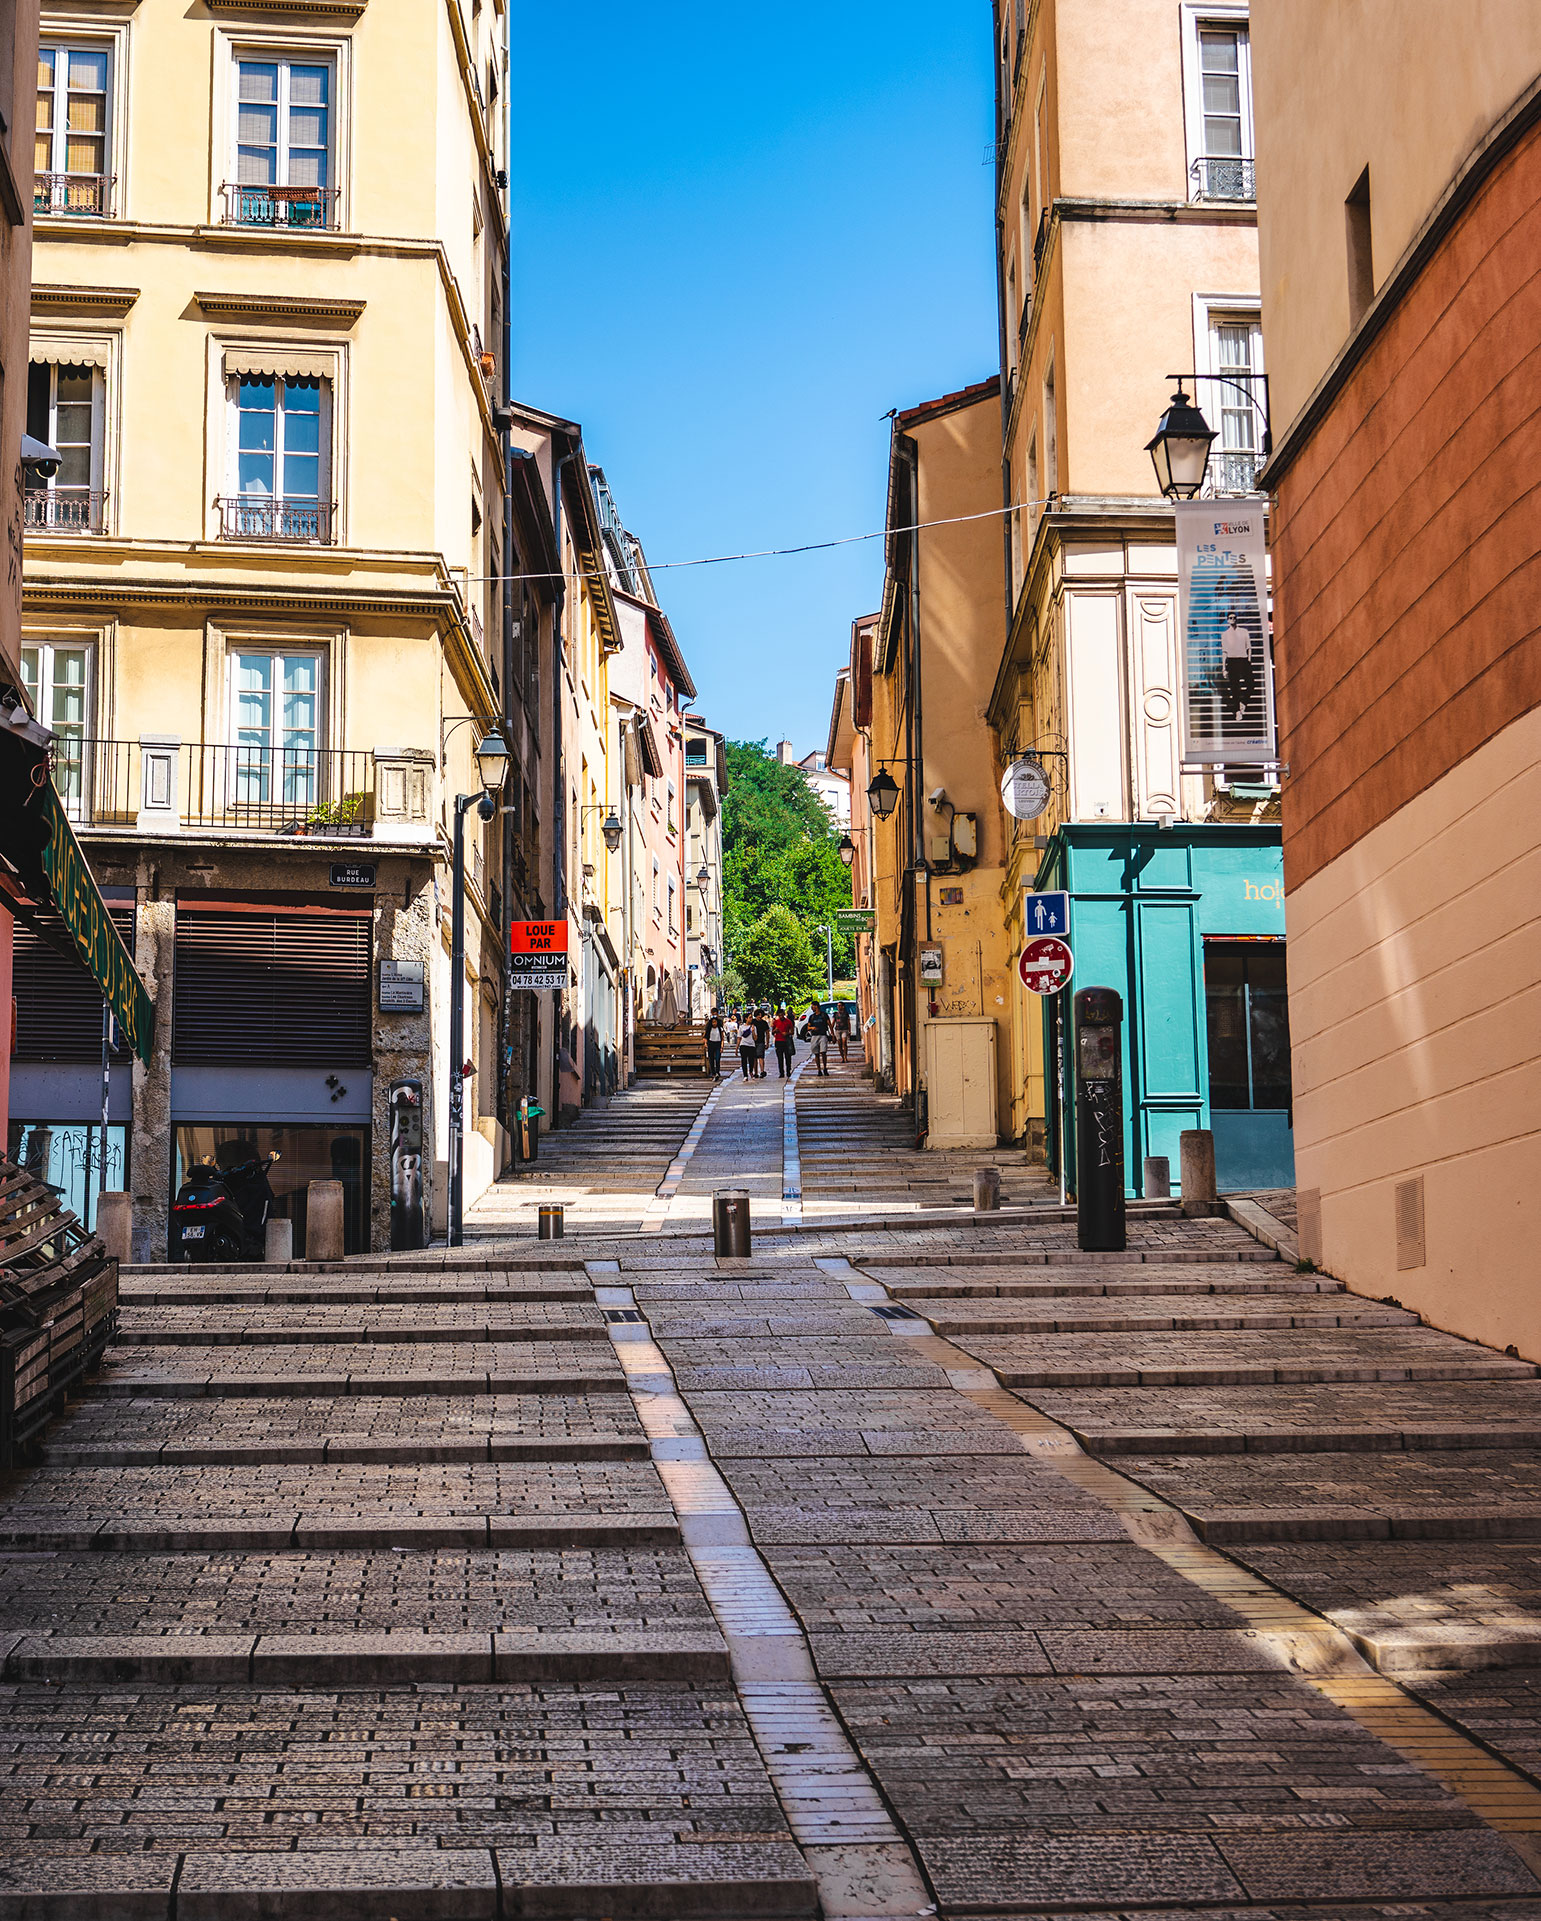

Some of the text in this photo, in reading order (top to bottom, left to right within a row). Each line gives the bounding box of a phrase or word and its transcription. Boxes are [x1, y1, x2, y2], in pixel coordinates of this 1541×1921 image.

[1228, 525, 1250, 534] LYON
[1196, 544, 1216, 552] LES
[1197, 550, 1246, 566] PENTES
[526, 925, 555, 936] LOUE
[530, 938, 551, 949] PAR
[514, 955, 565, 966] OMNIUM
[512, 975, 566, 985] 04 78 42 53 17
